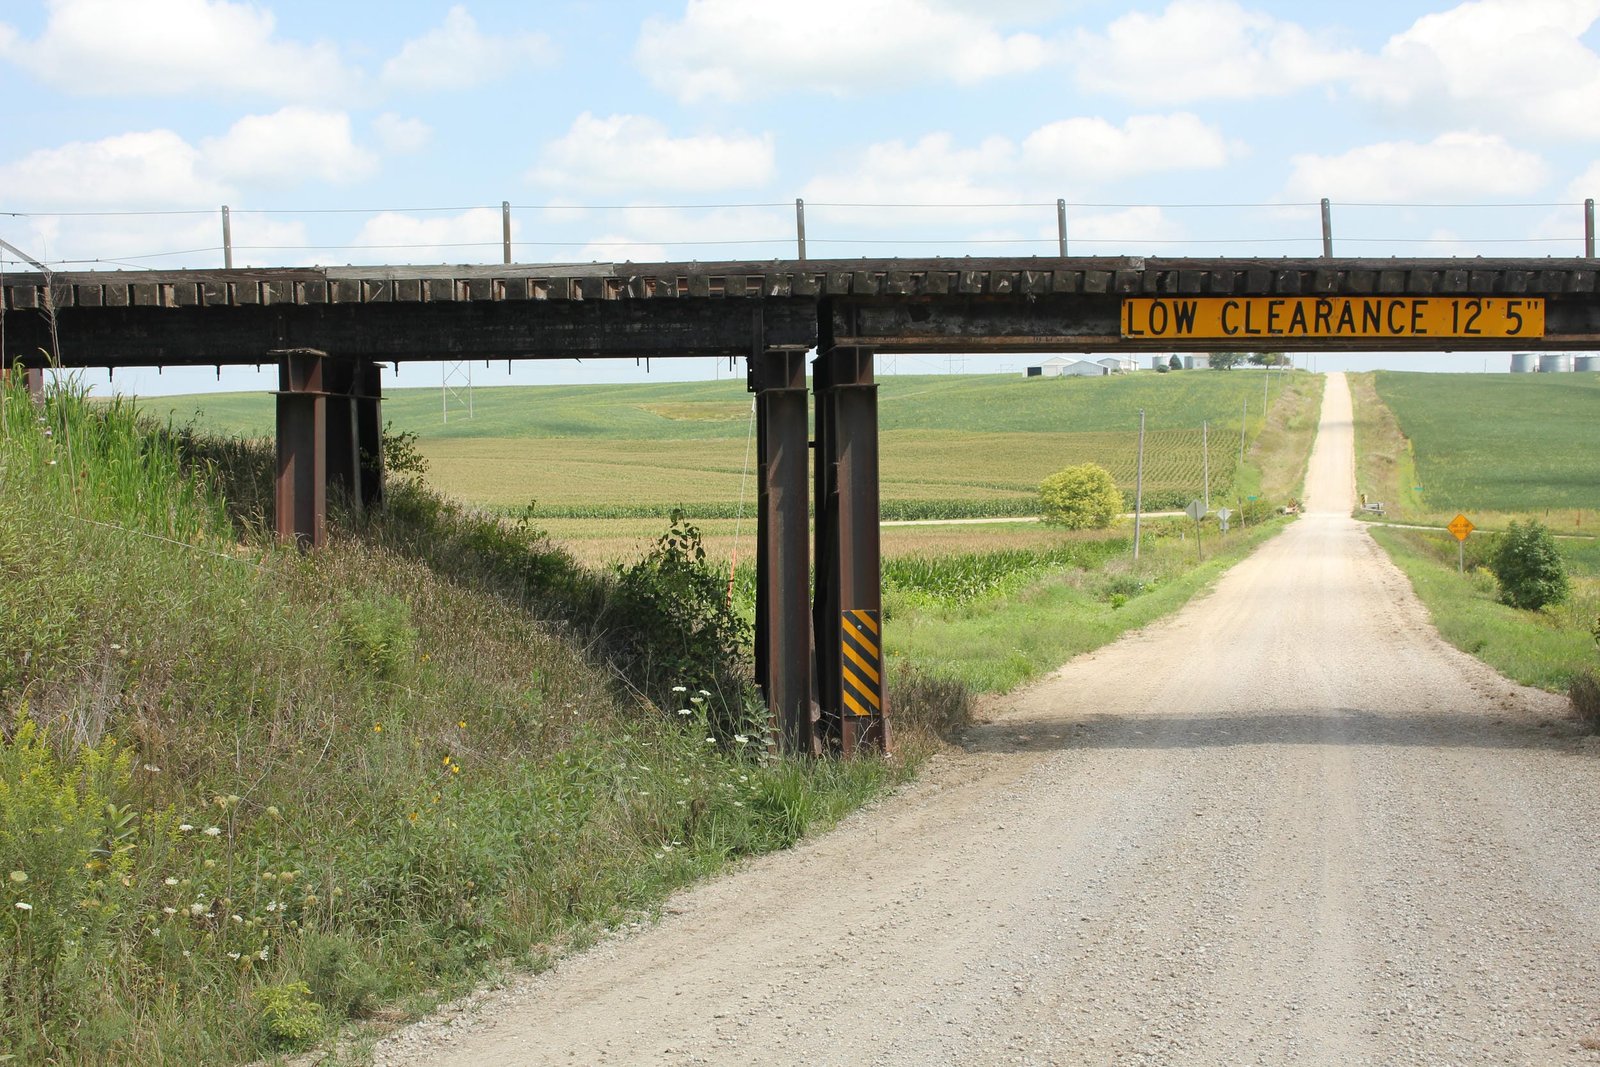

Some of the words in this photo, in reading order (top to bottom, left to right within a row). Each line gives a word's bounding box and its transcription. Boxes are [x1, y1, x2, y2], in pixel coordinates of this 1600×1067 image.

[1127, 300, 1198, 335] LOW
[1221, 300, 1429, 335] CLEARANCE
[1451, 300, 1491, 335] 12'
